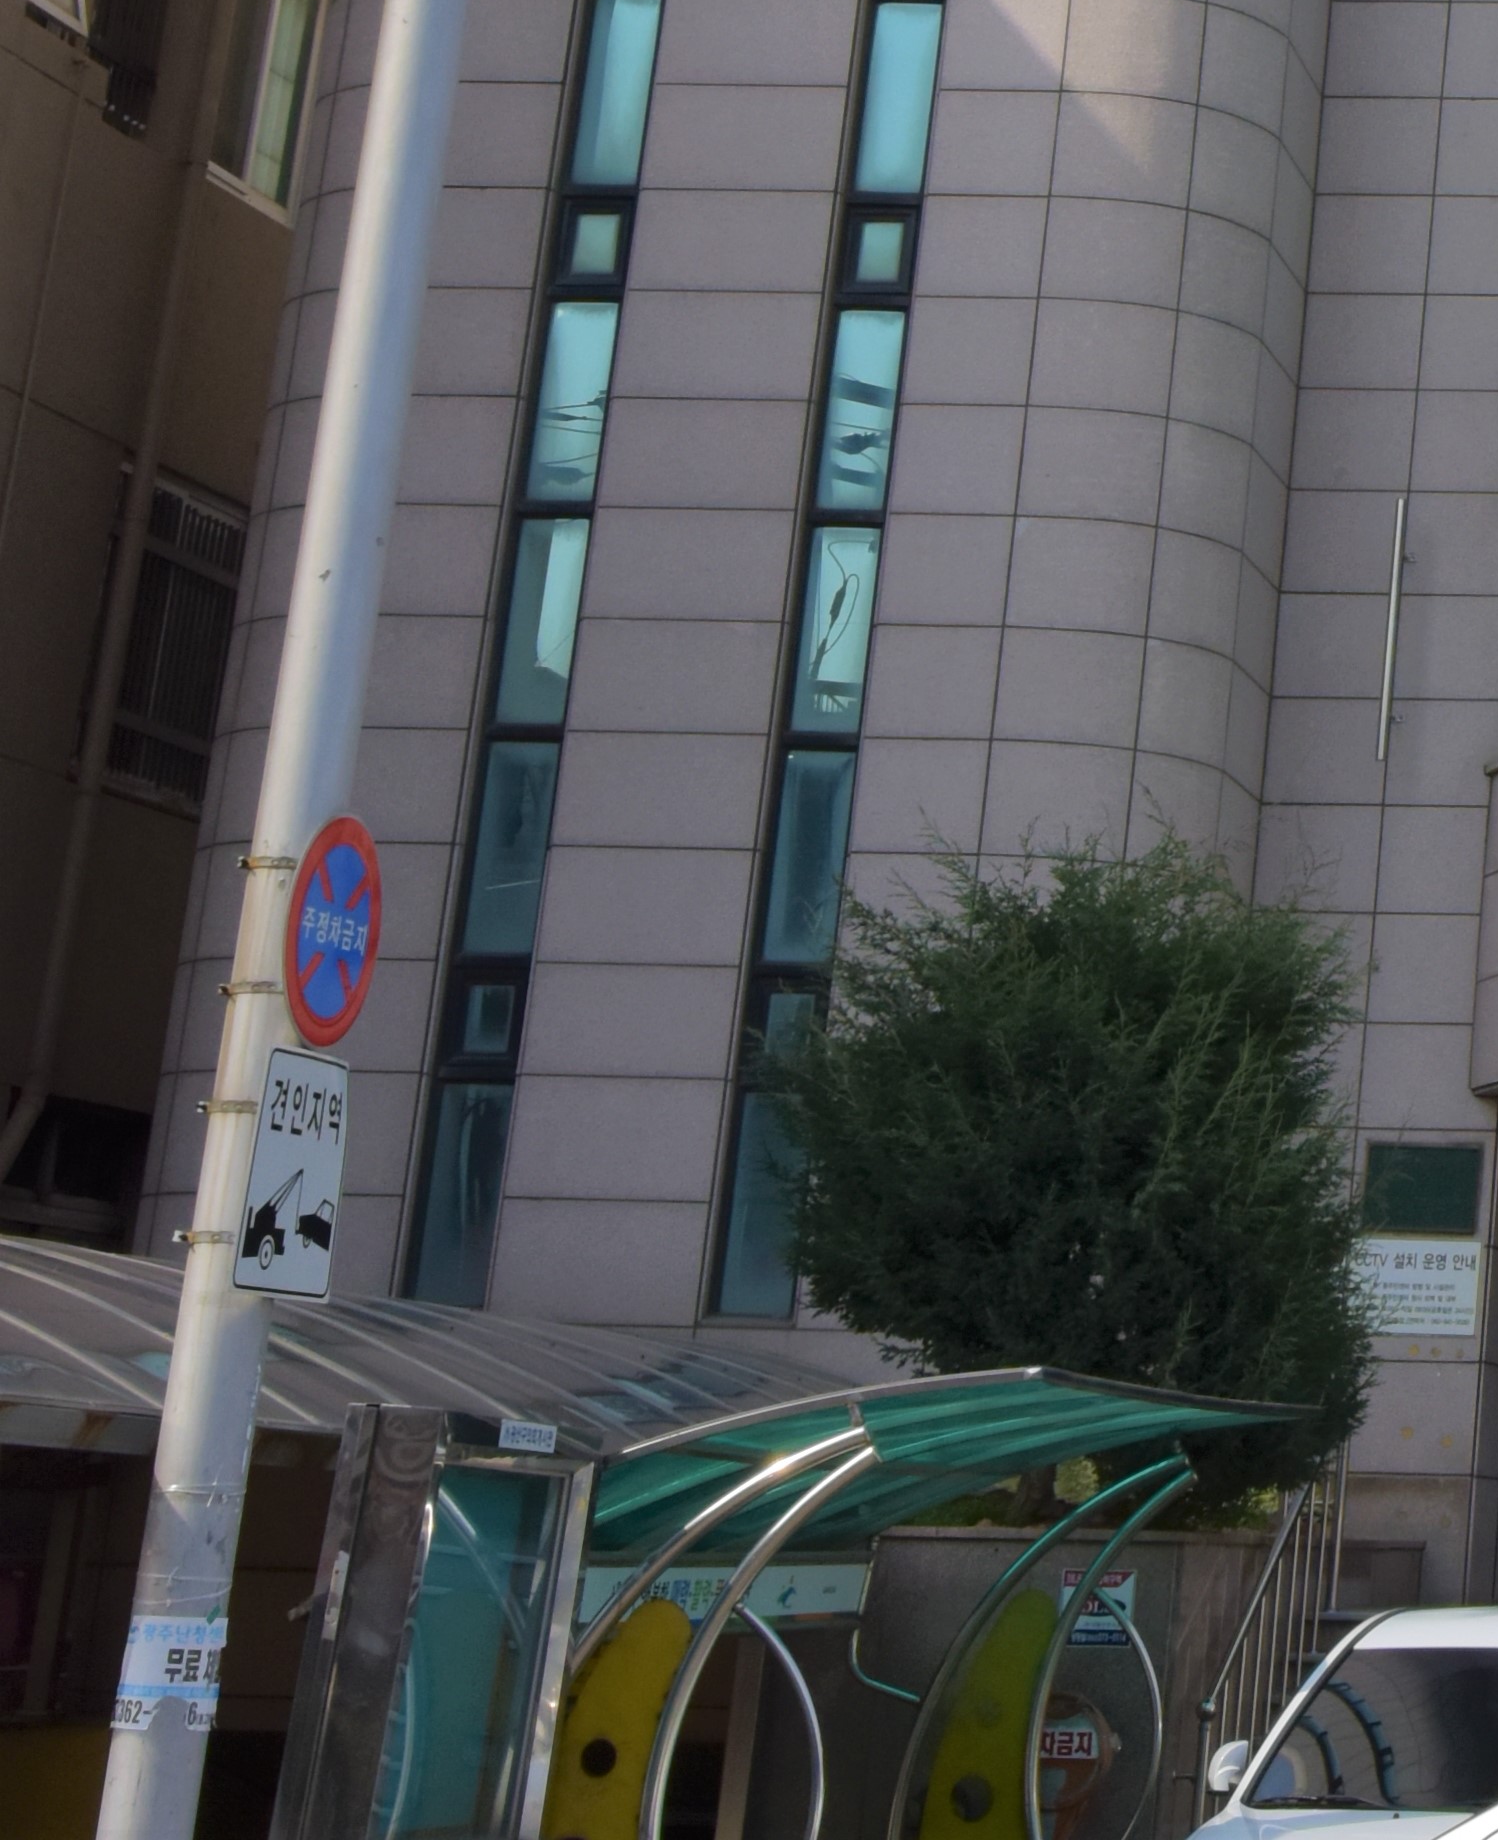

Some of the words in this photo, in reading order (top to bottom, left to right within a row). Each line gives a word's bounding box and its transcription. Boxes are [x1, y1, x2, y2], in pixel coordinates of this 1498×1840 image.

[302, 906, 368, 957] 주정차금지
[270, 1078, 343, 1146] 견인지역
[1393, 1252, 1418, 1270] 설치
[1422, 1252, 1448, 1271] 운영
[1452, 1253, 1477, 1271] 안내
[164, 1648, 203, 1683] 무료
